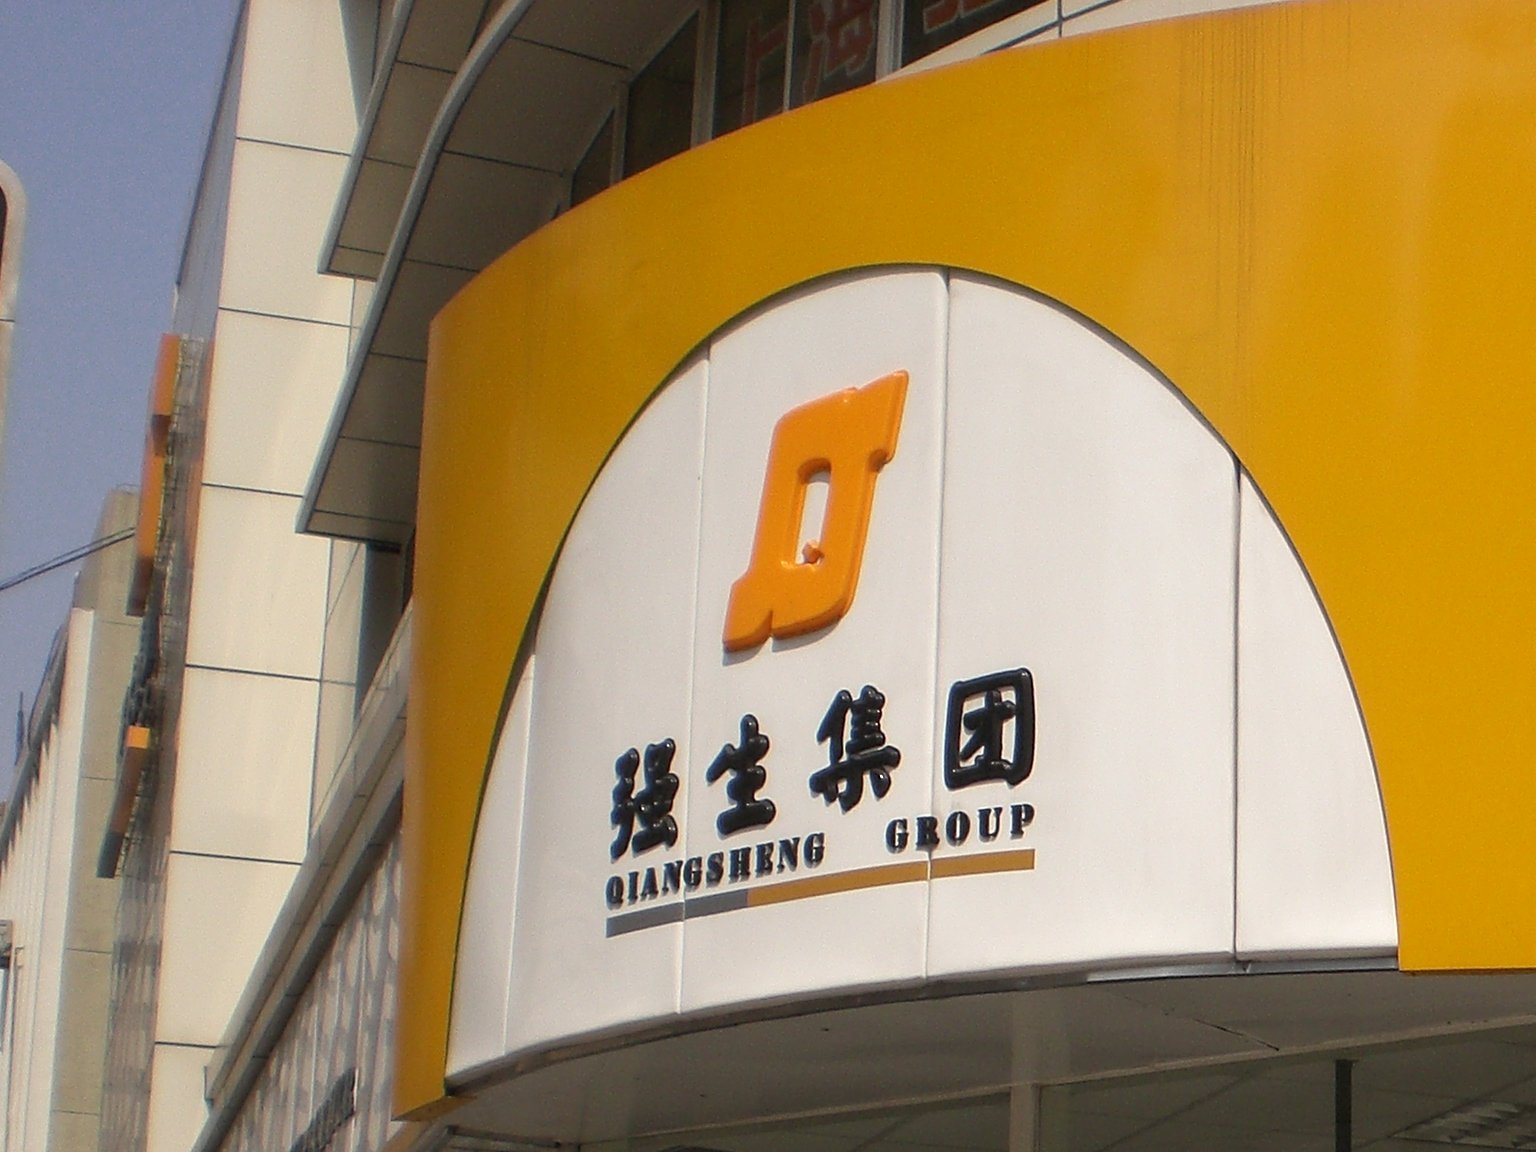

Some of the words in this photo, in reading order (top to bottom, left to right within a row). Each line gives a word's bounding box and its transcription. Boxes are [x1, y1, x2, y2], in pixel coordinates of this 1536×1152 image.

[610, 666, 1036, 862] 强生集团
[605, 832, 826, 910] QIANGSHENG
[886, 803, 1036, 853] GROUP
